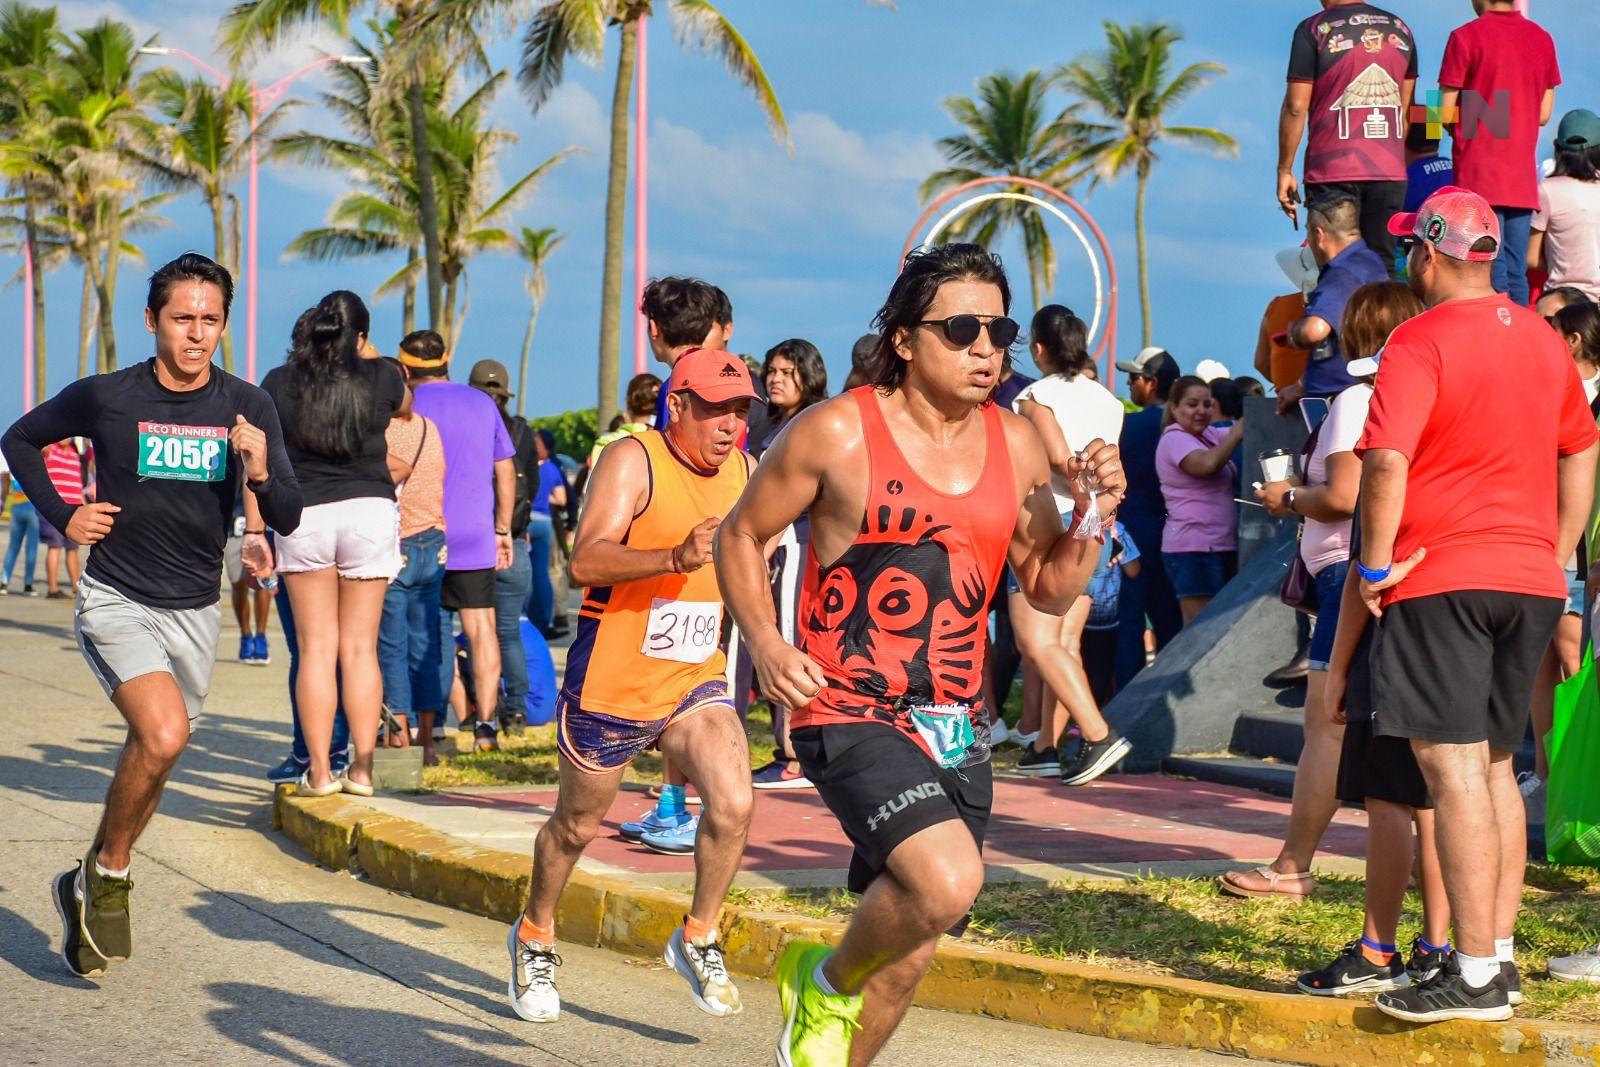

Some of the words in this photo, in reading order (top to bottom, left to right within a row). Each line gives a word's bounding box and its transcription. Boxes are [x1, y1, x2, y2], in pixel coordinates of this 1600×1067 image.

[147, 424, 169, 434] ECO
[172, 426, 217, 437] RUNNERS
[146, 436, 219, 470] 2058
[650, 612, 716, 651] 3188
